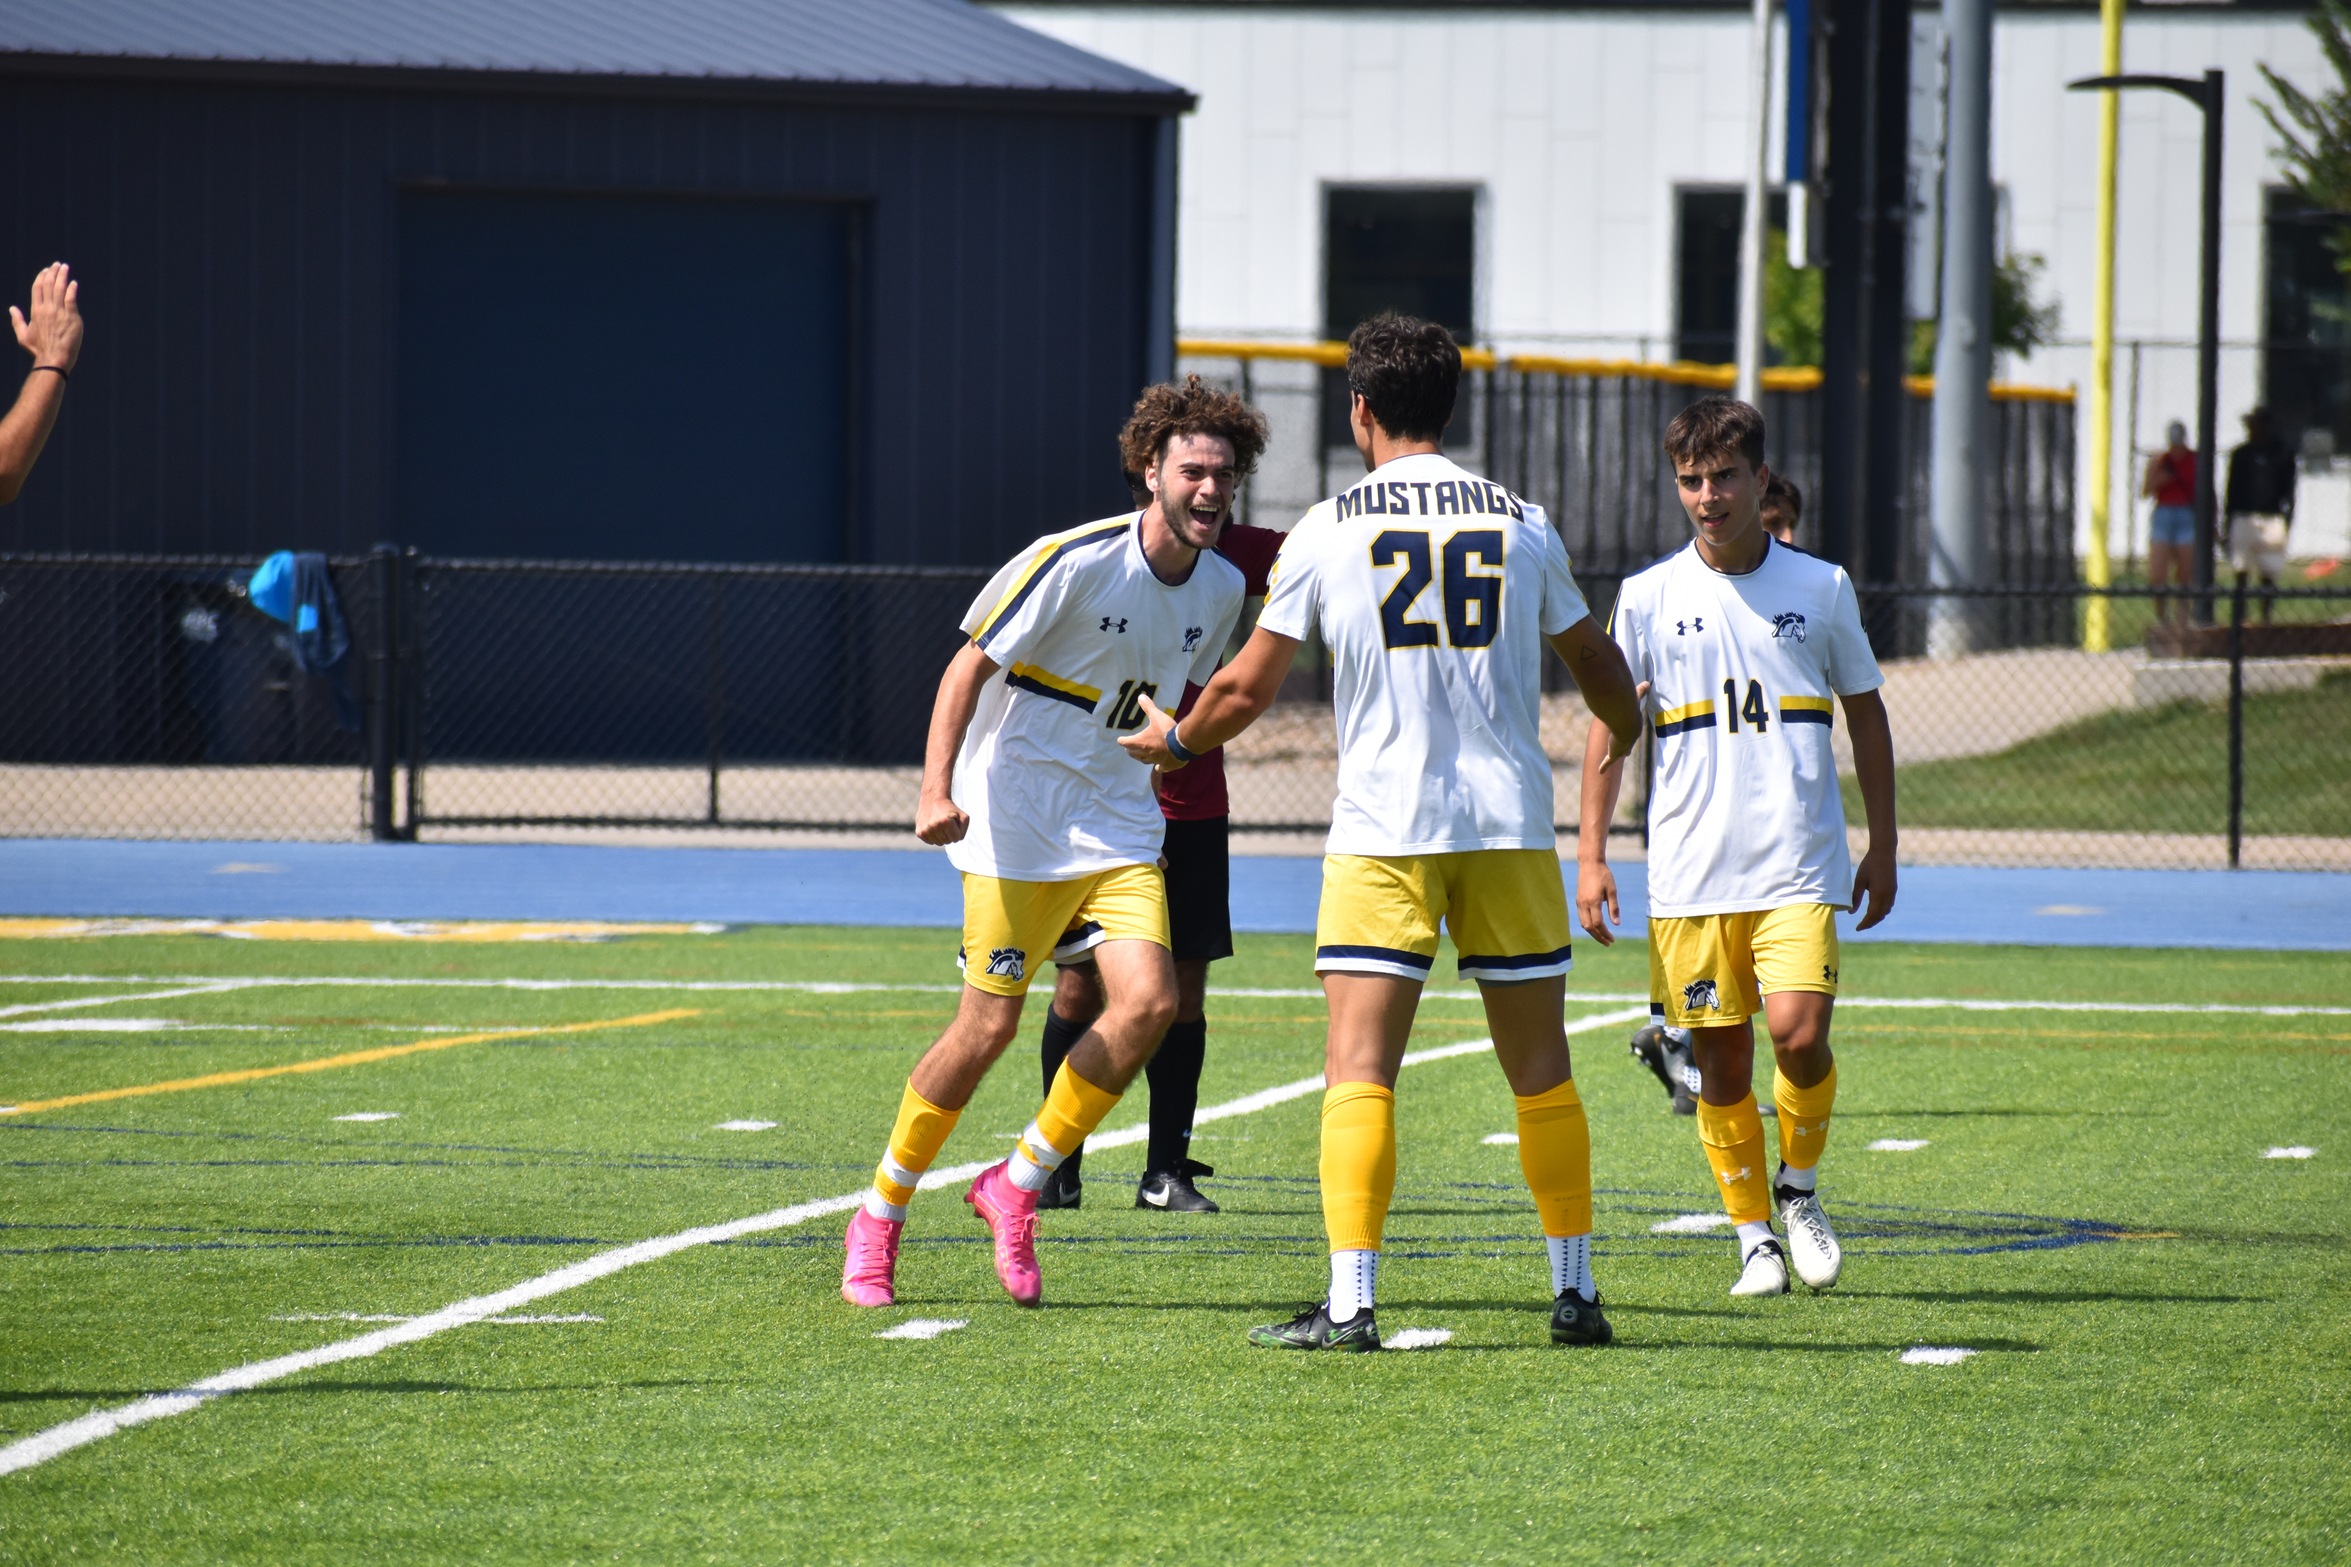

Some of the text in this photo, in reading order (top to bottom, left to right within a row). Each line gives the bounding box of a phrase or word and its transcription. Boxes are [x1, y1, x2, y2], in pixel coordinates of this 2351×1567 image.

[1336, 481, 1525, 524] MUSTANGS
[1368, 528, 1505, 651] 26
[1105, 679, 1158, 731] 10
[1723, 677, 1769, 734] 14
